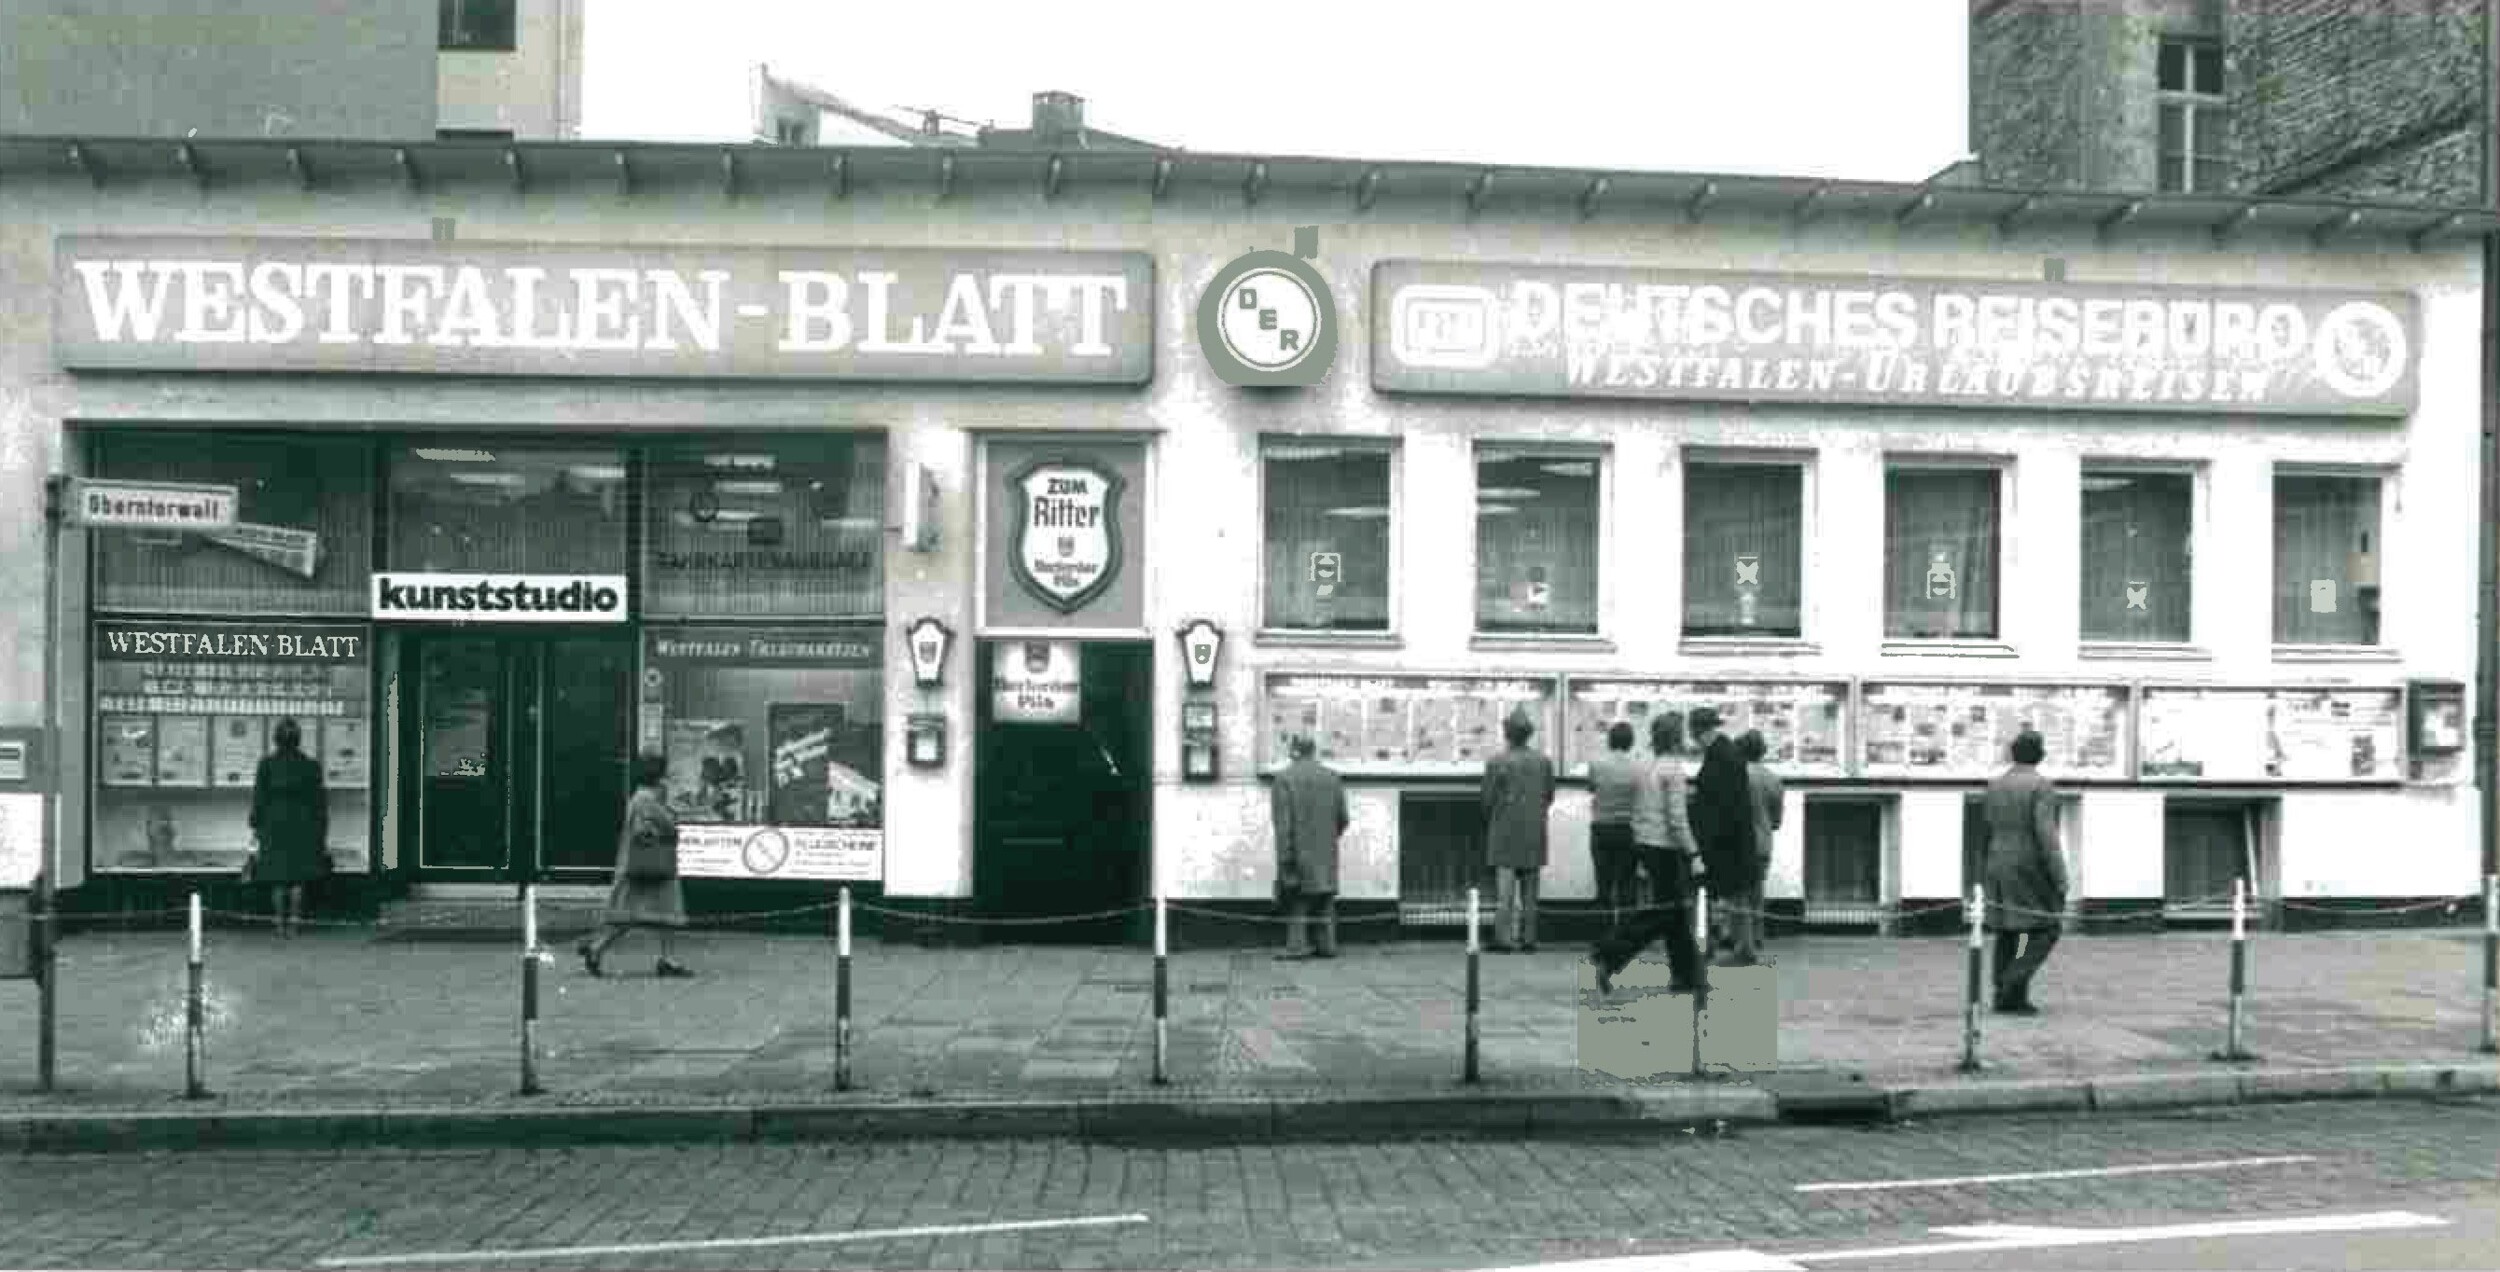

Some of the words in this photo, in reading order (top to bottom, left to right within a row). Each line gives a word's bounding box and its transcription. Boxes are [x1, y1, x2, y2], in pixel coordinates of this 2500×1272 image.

[74, 260, 1128, 356] WESTFALEN-BLATT
[1238, 287, 1299, 351] DER
[1510, 281, 1918, 346] DEUTSCHES
[1034, 496, 1099, 528] Ritter
[379, 577, 618, 613] kunststudio
